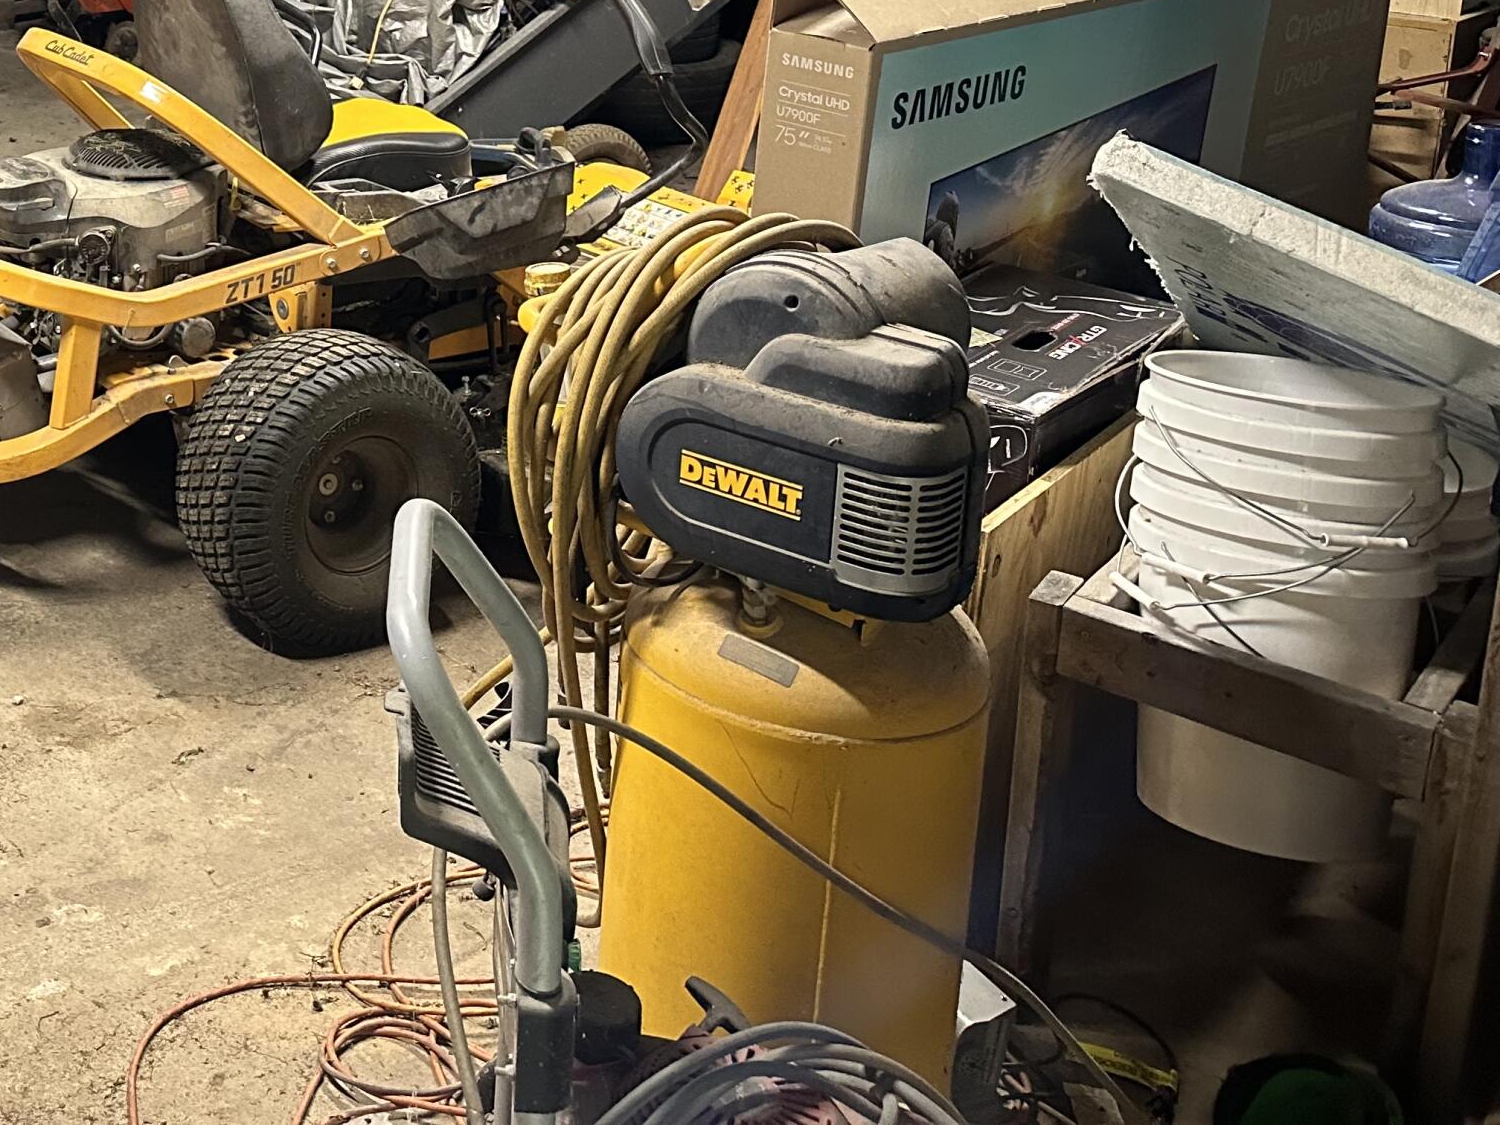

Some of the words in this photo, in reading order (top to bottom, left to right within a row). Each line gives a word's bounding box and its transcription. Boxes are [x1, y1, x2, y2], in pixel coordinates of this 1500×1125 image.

[781, 52, 855, 79] SAMSUNG
[778, 85, 823, 105] Crystal
[825, 96, 851, 111] UHD
[891, 64, 1027, 130] SAMSUNG
[776, 105, 821, 125] U7900F
[225, 272, 266, 305] ZT1
